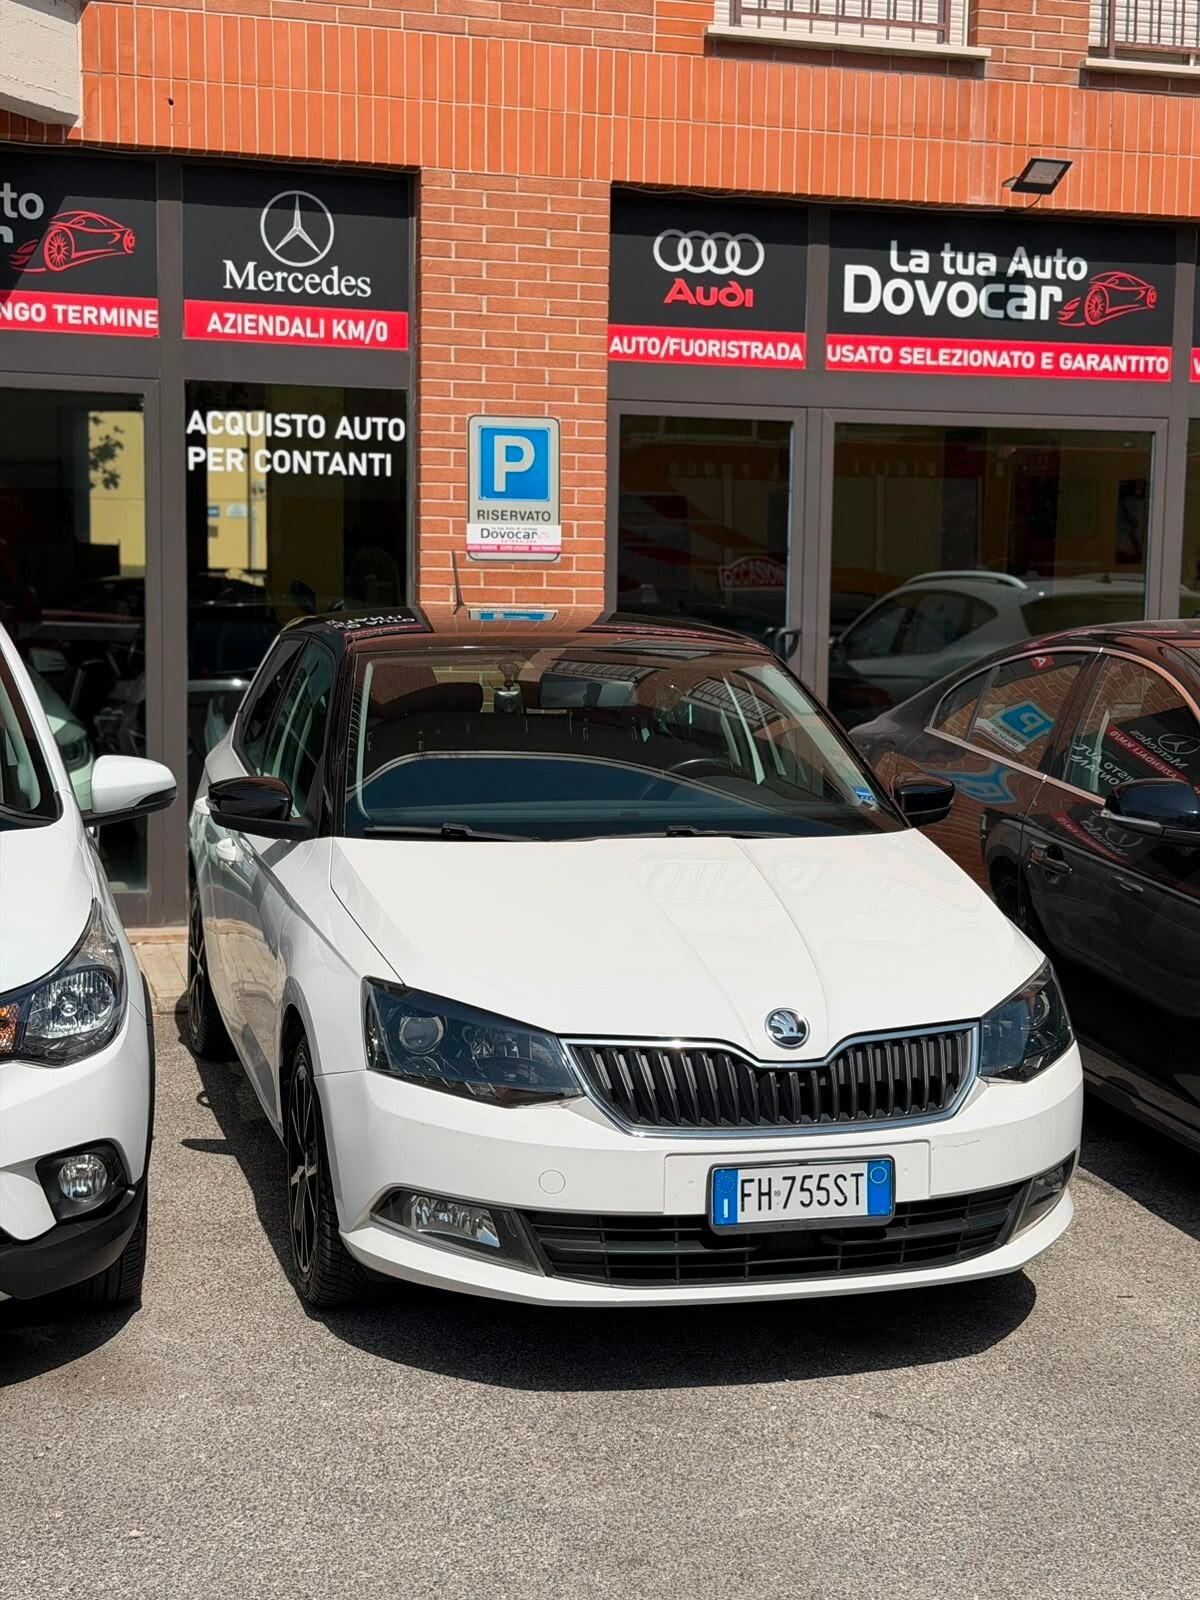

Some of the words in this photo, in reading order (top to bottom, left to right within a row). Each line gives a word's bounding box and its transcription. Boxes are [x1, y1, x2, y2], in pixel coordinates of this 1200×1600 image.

[890, 240, 930, 274] La
[941, 242, 997, 277] tua
[1007, 246, 1089, 281] Auto
[222, 260, 372, 298] Mercedes
[663, 278, 754, 308] Audi
[843, 264, 1063, 322] Dovocar
[53, 304, 159, 329] TERMINE
[207, 312, 325, 339] AZIENDALI
[332, 319, 389, 345] KM/0
[609, 335, 804, 362] AUTO/FUORISTRADA
[827, 343, 892, 364] USATO
[899, 345, 1036, 369] SELEZIONATO
[1041, 350, 1056, 369] E
[1058, 350, 1169, 374] GARANTITO
[186, 410, 327, 440] ACQUISTO
[335, 416, 407, 442] AUTO
[187, 447, 246, 473] PER
[254, 450, 393, 477] CONTANTI
[493, 435, 536, 493] P
[477, 509, 552, 522] RISERVATO
[480, 528, 539, 540] Dovocar
[740, 1177, 772, 1212] FH
[782, 1172, 865, 1209] 755ST
